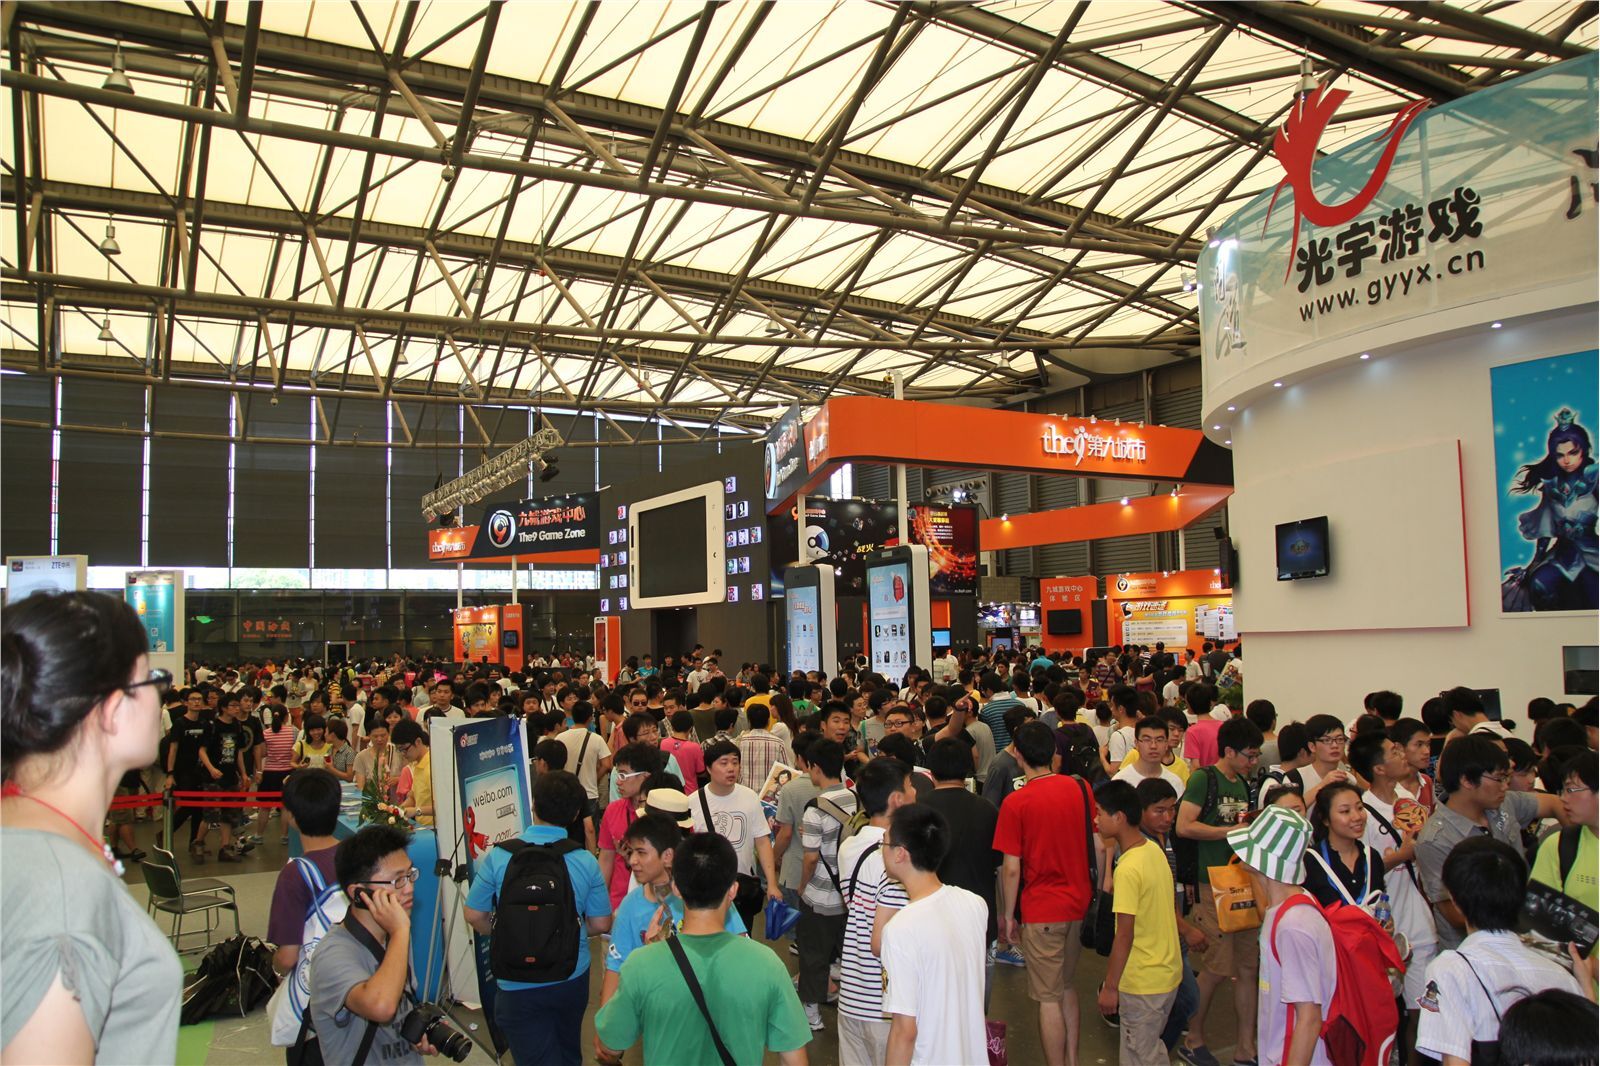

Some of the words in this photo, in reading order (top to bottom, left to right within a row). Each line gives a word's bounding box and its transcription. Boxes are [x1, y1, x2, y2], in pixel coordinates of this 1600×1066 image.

[1296, 187, 1483, 293] 光宇游戏
[1299, 250, 1485, 322] www.gyyx.cn
[1088, 434, 1147, 460] 第九城市
[518, 531, 538, 543] The9
[538, 530, 564, 541] Game
[564, 528, 586, 539] Zone
[472, 785, 514, 807] weibo.com
